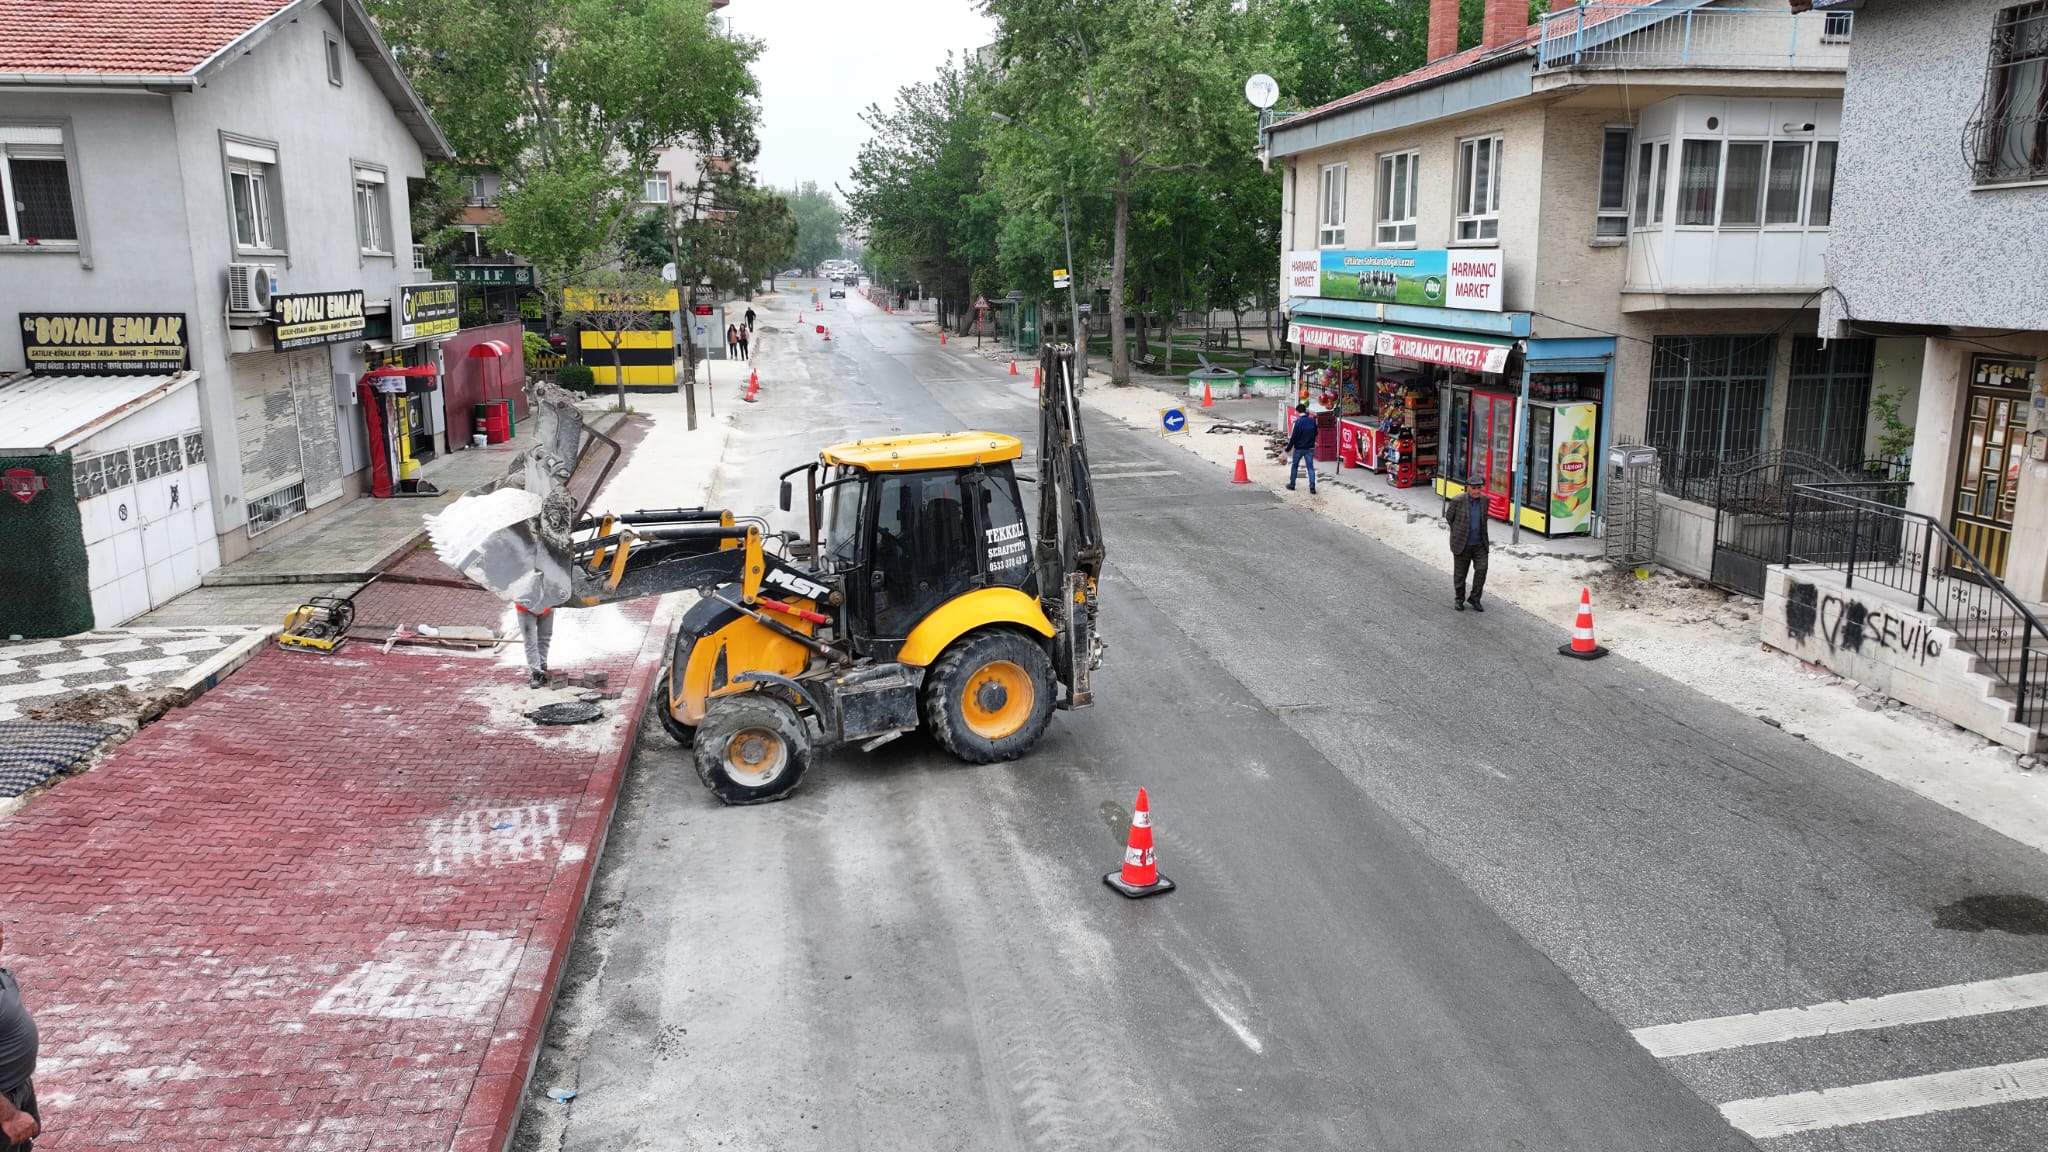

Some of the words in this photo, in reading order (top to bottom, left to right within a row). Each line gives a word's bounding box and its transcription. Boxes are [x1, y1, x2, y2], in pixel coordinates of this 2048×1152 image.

[1291, 260, 1318, 272] HARMANCI
[1451, 262, 1497, 278] HARMANCI
[1294, 275, 1315, 288] MARKET
[1455, 282, 1490, 299] MARKET
[283, 296, 325, 324] BOYALI
[326, 293, 363, 319] EMLAK
[35, 317, 107, 345] BOYALI
[112, 317, 182, 346] EMLAK
[1400, 339, 1442, 361] HARMANCI
[1442, 347, 1480, 367] MARKET
[985, 518, 1025, 544] TEKKELİ
[987, 539, 1026, 560] ŞERAFETTİN
[989, 560, 1005, 572] 0533
[765, 568, 831, 599] MST
